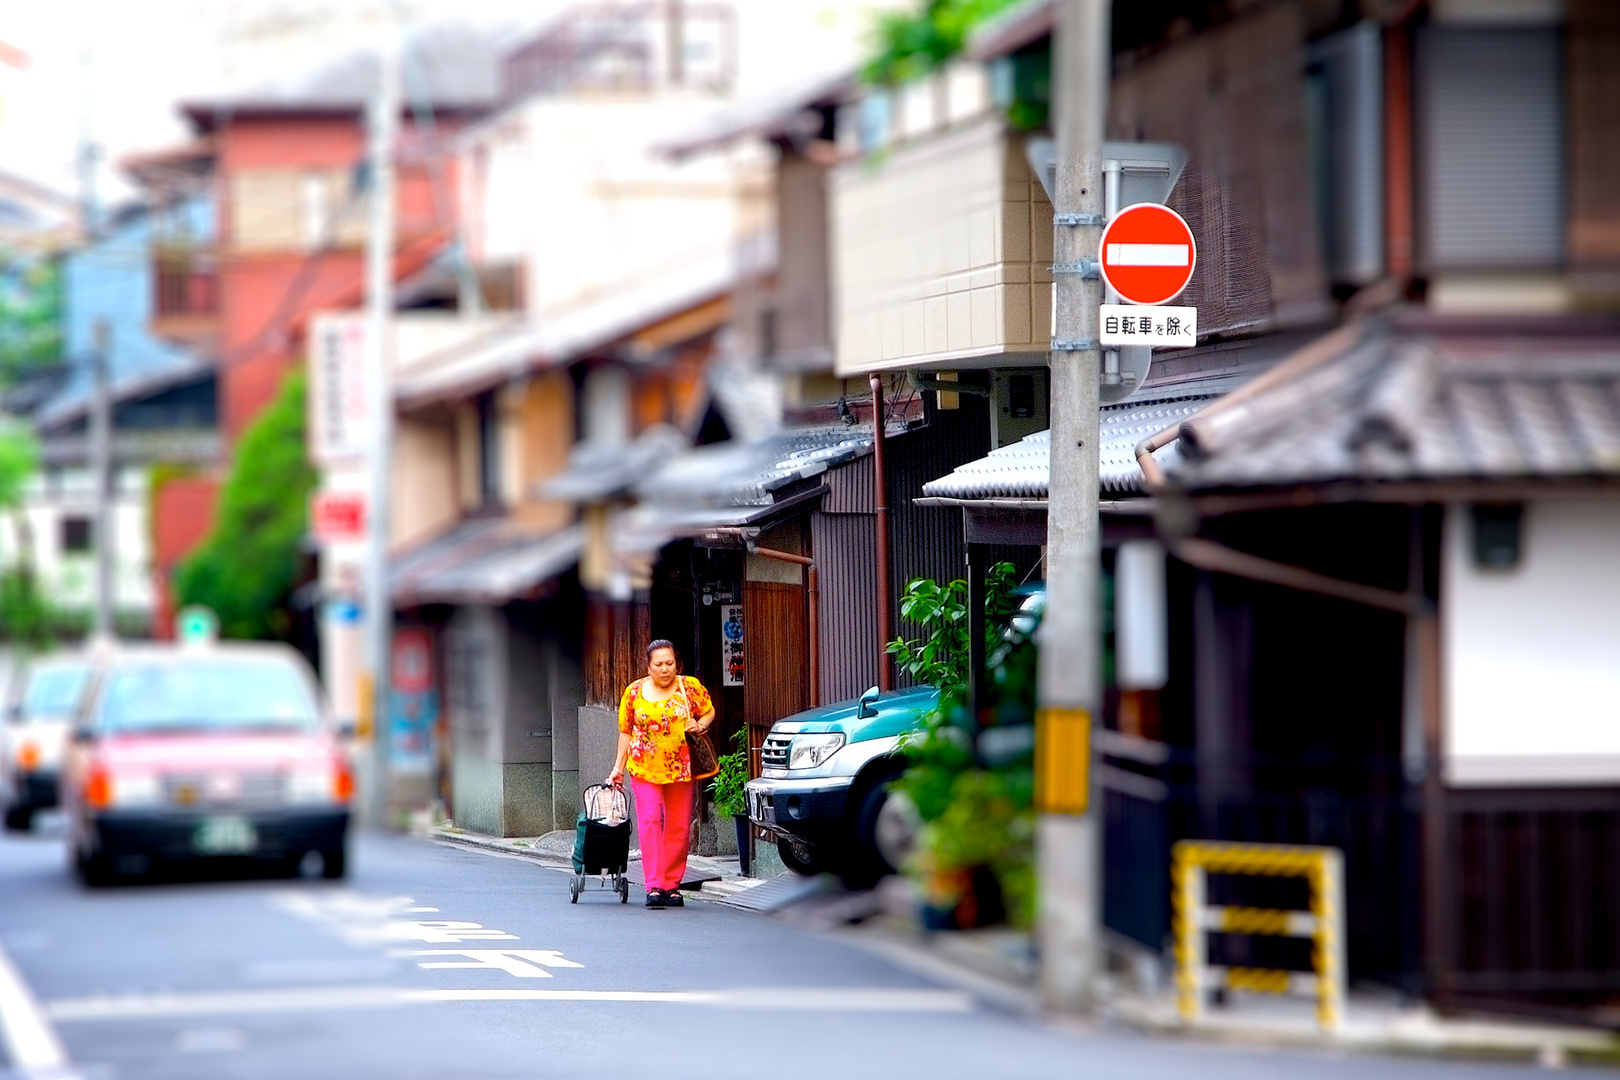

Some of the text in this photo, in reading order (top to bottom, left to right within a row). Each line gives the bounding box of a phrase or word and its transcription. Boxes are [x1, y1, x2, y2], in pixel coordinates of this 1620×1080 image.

[1106, 315, 1192, 337] 自転車を除く
